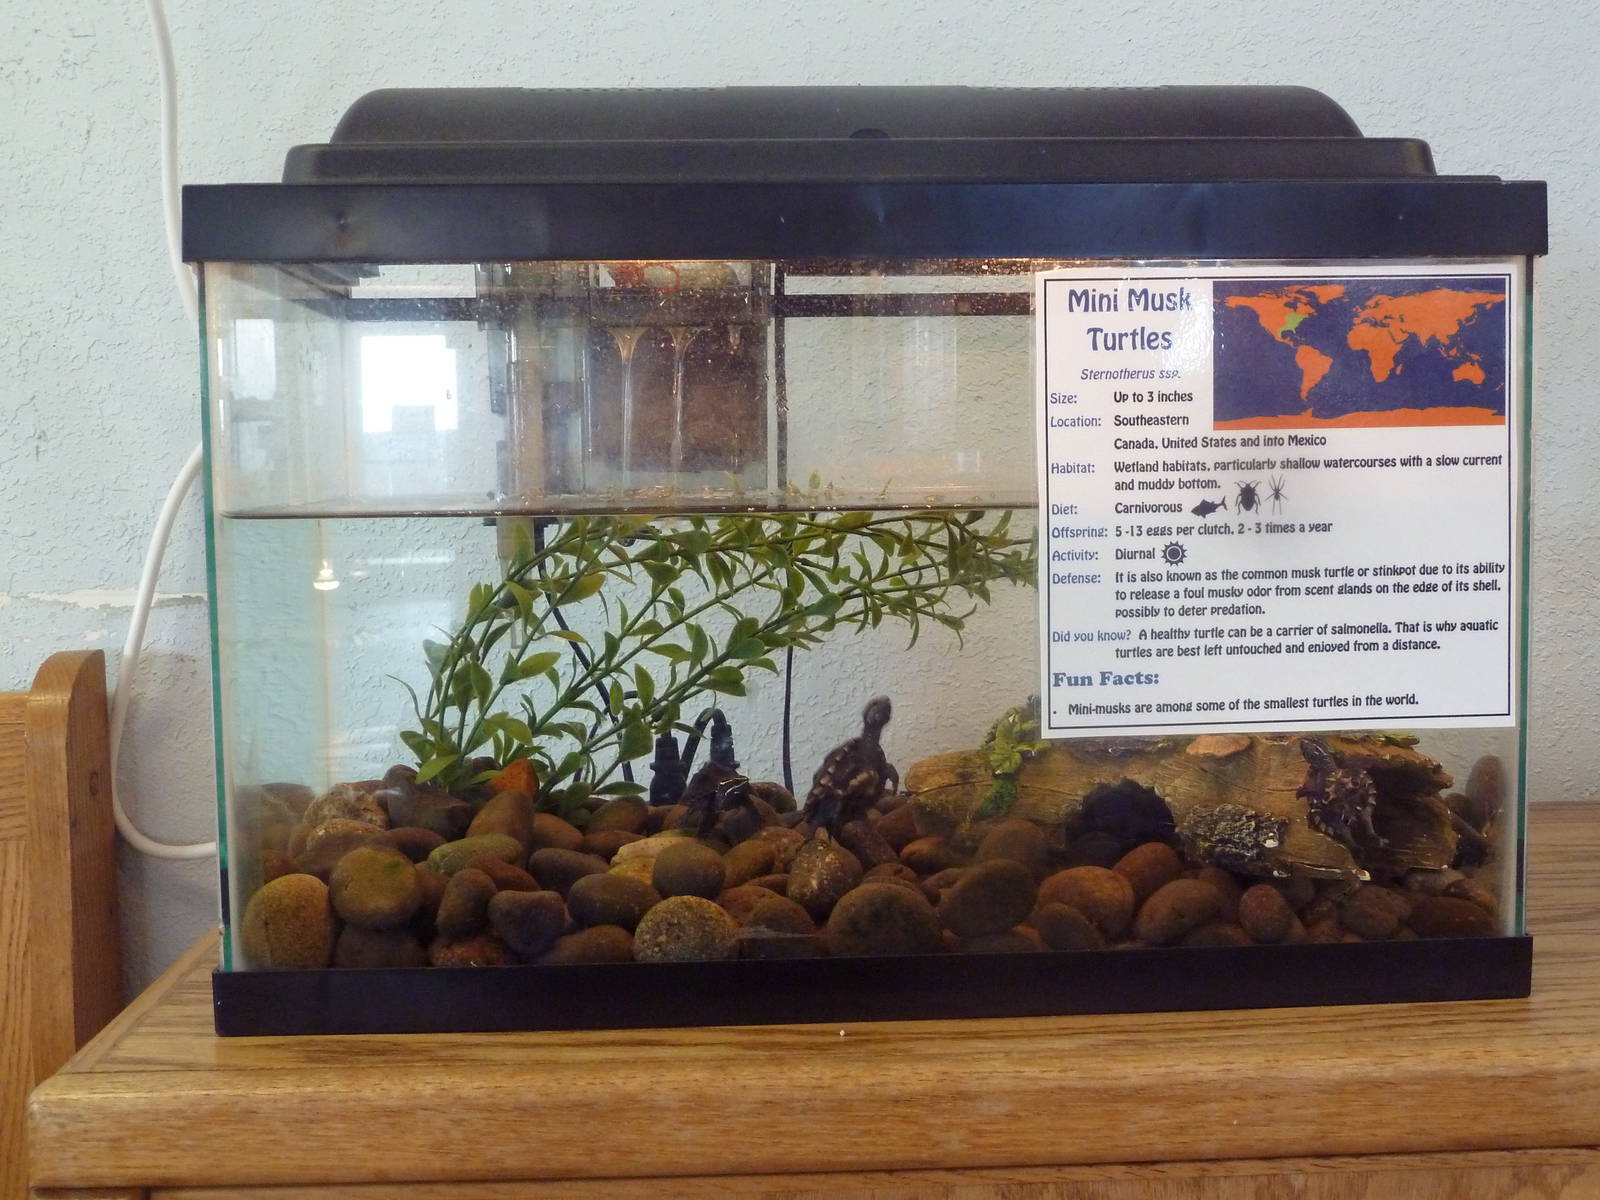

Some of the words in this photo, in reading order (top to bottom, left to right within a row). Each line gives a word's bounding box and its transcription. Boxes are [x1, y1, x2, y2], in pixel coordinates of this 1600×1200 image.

[1068, 288, 1118, 312] Mini
[1128, 287, 1192, 312] Musk
[1087, 327, 1172, 351] Turtles
[1080, 368, 1155, 380] Sternotherus
[1050, 392, 1077, 404] Size:
[1114, 391, 1129, 403] Up
[1132, 392, 1143, 402] to
[1147, 391, 1154, 402] 3
[1158, 391, 1193, 402] inches
[1050, 416, 1101, 428] Location:
[1114, 414, 1189, 427] Southeastern
[1162, 437, 1197, 448] United
[1201, 436, 1236, 448] States
[1240, 436, 1260, 447] and
[1264, 435, 1284, 447] into
[1288, 435, 1326, 446] Mexico
[1051, 462, 1095, 474] Habitat:
[1114, 461, 1158, 472] Wetland
[1214, 459, 1276, 471] particularly
[1280, 457, 1320, 469] shallow
[1324, 457, 1396, 469] watercourses
[1400, 455, 1422, 467] with
[1426, 457, 1432, 467] a
[1436, 454, 1459, 466] slow
[1463, 454, 1502, 466] current
[1114, 479, 1134, 491] and
[1138, 478, 1175, 491] muddy
[1179, 478, 1221, 490] bottom.
[1052, 504, 1078, 515] Diet:
[1115, 502, 1182, 514] Carnivorous
[1052, 526, 1108, 538] Offspring:
[1146, 526, 1173, 537] eggs
[1176, 526, 1194, 535] per
[1238, 523, 1244, 534] 2
[1255, 523, 1262, 533] 3
[1265, 522, 1295, 534] times
[1299, 523, 1305, 532] a
[1309, 523, 1333, 532] year
[1052, 550, 1098, 561] Activity:
[1115, 548, 1155, 560] Diurnal
[1052, 573, 1101, 584] Defense:
[1115, 572, 1124, 583] It
[1128, 571, 1136, 582] is
[1140, 571, 1163, 583] also
[1166, 571, 1201, 582] known
[1205, 571, 1217, 581] as
[1221, 570, 1239, 581] the
[1242, 569, 1288, 580] common
[1292, 567, 1321, 578] musk
[1324, 566, 1354, 578] turtle
[1358, 567, 1370, 577] or
[1372, 565, 1416, 576] stinkpot
[1420, 564, 1439, 576] due
[1442, 564, 1452, 575] to
[1456, 563, 1470, 574] its
[1473, 563, 1505, 574] ability
[1115, 590, 1126, 601] to
[1130, 588, 1170, 600] release
[1174, 590, 1180, 599] a
[1183, 587, 1204, 599] foul
[1208, 587, 1243, 599] musky
[1247, 586, 1272, 597] odor
[1275, 585, 1301, 596] from
[1305, 584, 1334, 596] scent
[1337, 583, 1372, 595] glands
[1376, 584, 1389, 594] on
[1392, 582, 1409, 593] the
[1413, 581, 1439, 593] edge
[1442, 580, 1452, 592] of
[1456, 580, 1469, 591] its
[1473, 580, 1501, 591] shell.
[1115, 606, 1160, 618] possibly
[1164, 606, 1175, 617] to
[1178, 605, 1207, 616] deter
[1210, 604, 1265, 616] predation.
[1052, 631, 1070, 642] Did
[1074, 632, 1094, 642] you
[1097, 630, 1131, 641] know?
[1138, 629, 1147, 640] A
[1151, 628, 1190, 640] healthy
[1194, 627, 1224, 639] turtle
[1228, 627, 1246, 638] can
[1250, 626, 1263, 637] be
[1266, 627, 1272, 636] a
[1276, 625, 1313, 636] carrier
[1317, 624, 1328, 635] of
[1331, 623, 1392, 635] salmonella.
[1395, 622, 1420, 632] That
[1423, 621, 1432, 632] is
[1436, 621, 1456, 632] why
[1460, 620, 1498, 631] aquatic
[1115, 646, 1152, 658] turtles
[1156, 647, 1174, 657] are
[1177, 645, 1200, 656] best
[1204, 644, 1222, 656] left
[1226, 642, 1282, 655] untouched
[1286, 642, 1304, 654] and
[1308, 641, 1350, 653] enjoyed
[1353, 640, 1379, 651] from
[1382, 641, 1389, 650] a
[1392, 639, 1440, 650] distance.
[1053, 672, 1093, 687] Fun
[1100, 671, 1159, 686] Facts:
[1069, 702, 1131, 716] Mini-musks
[1134, 703, 1152, 713] are
[1156, 701, 1192, 712] among
[1196, 701, 1225, 711] some
[1229, 699, 1240, 710] of
[1243, 698, 1260, 710] the
[1264, 696, 1308, 709] smallest
[1313, 696, 1348, 707] turtles
[1352, 695, 1362, 706] in
[1366, 694, 1382, 706] the
[1386, 694, 1419, 705] world.
